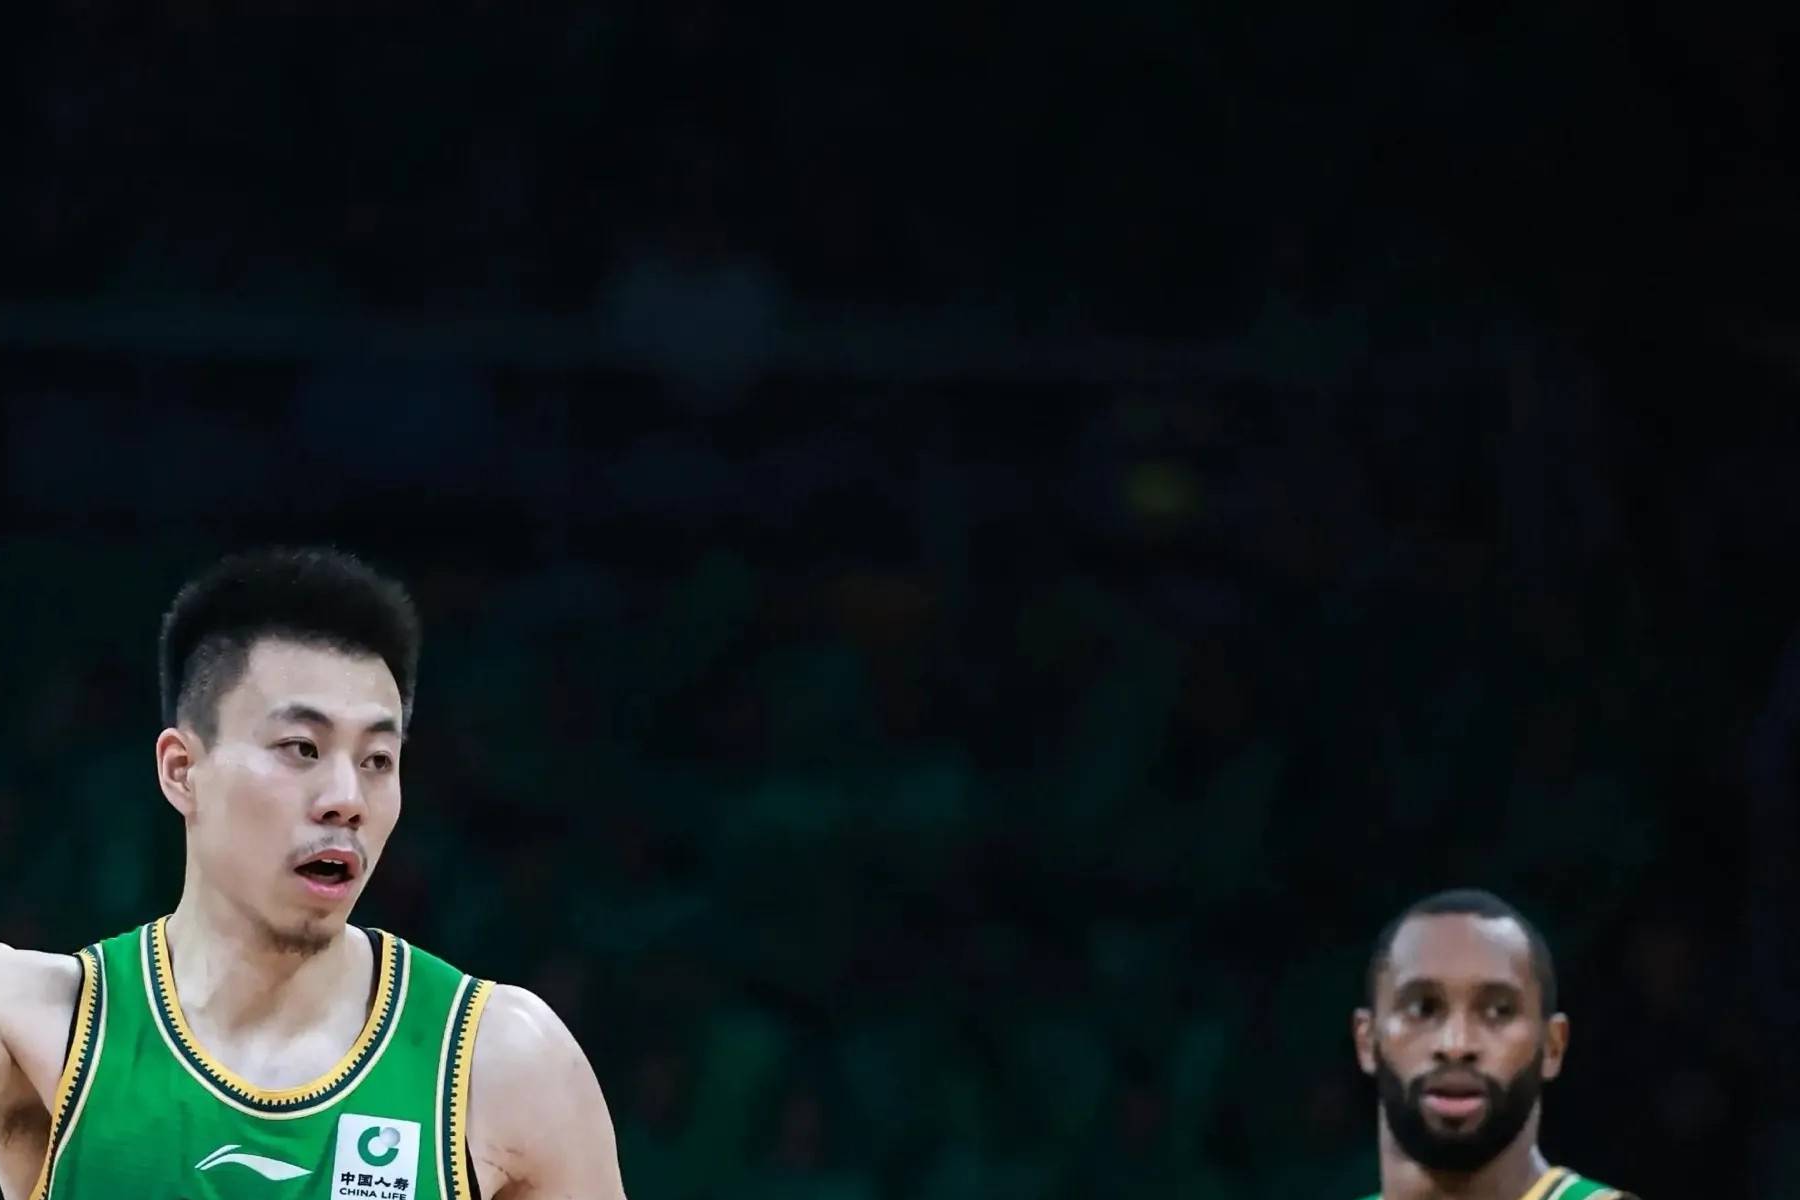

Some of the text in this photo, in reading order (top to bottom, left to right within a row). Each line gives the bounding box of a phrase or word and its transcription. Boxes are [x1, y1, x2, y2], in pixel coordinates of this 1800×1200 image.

[340, 1171, 409, 1191] 中国人寿
[339, 1187, 407, 1200] CHINA LIFE
